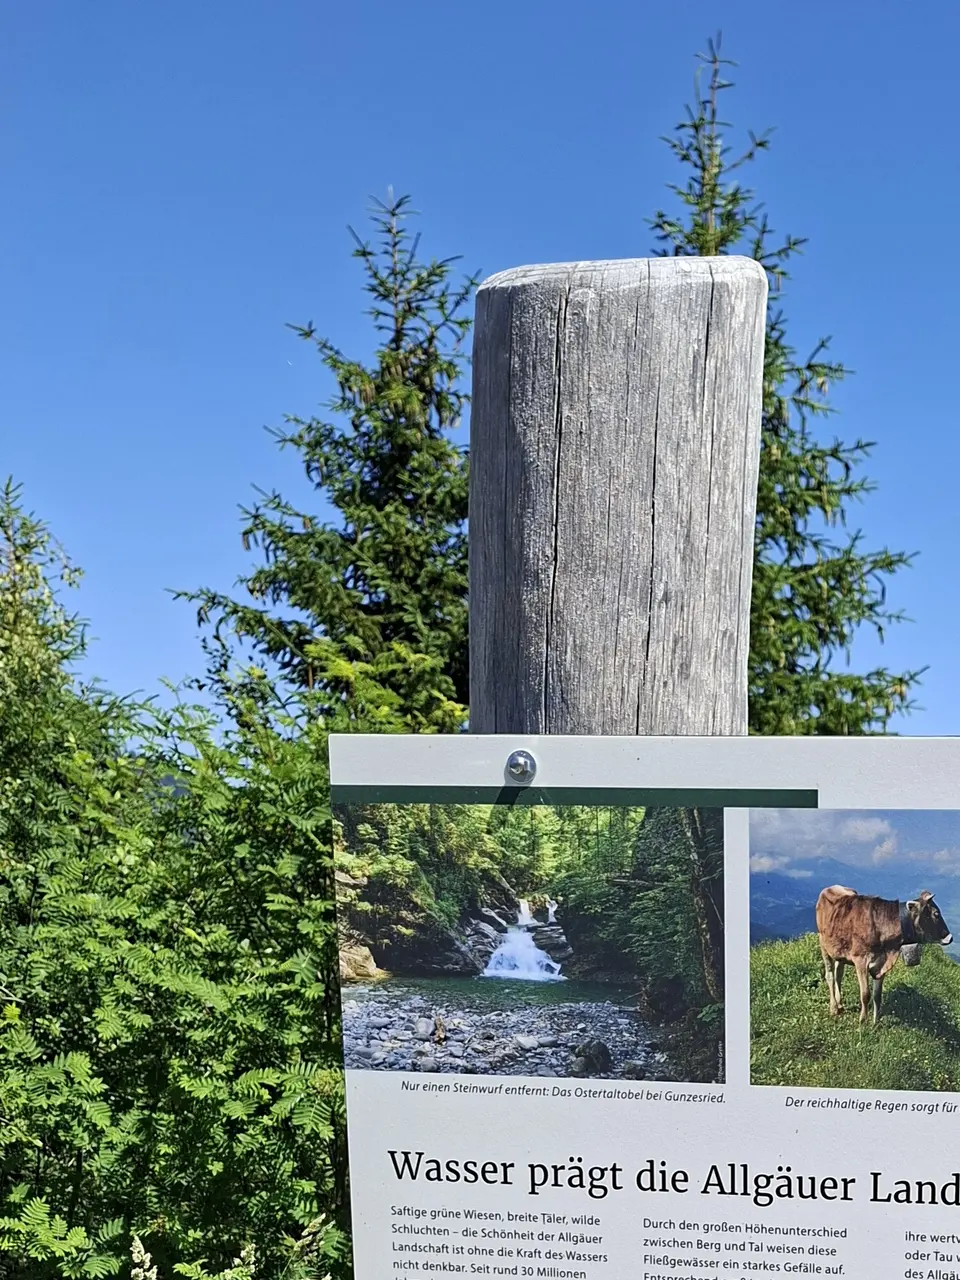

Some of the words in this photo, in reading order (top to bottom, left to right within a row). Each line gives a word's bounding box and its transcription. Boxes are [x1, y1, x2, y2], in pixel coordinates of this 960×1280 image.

[401, 1080, 421, 1091] Nur
[422, 1081, 450, 1092] einen
[453, 1082, 504, 1094] Steinwurf
[505, 1084, 549, 1097] entfernt:
[551, 1086, 573, 1098] Das
[574, 1087, 644, 1100] Ostertaltobel
[645, 1089, 663, 1101] bei
[664, 1090, 726, 1103] Gunzesried.
[785, 1096, 805, 1107] Der
[806, 1097, 872, 1112] reichhaltige
[874, 1099, 908, 1114] Regen
[910, 1102, 940, 1115] sorgt
[941, 1101, 958, 1113] für
[387, 1150, 515, 1185] Wasser
[527, 1156, 623, 1199] prägt
[636, 1159, 688, 1193] die
[700, 1163, 856, 1207] Allgäuer
[390, 1205, 427, 1219] Saftige
[429, 1207, 461, 1220] grüne
[463, 1208, 504, 1222] Wiesen,
[507, 1210, 538, 1223] breite
[540, 1212, 569, 1226] Täler,
[571, 1214, 600, 1226] wilde
[643, 1217, 676, 1230] Durch
[678, 1219, 699, 1231] den
[702, 1221, 742, 1234] großen
[744, 1222, 847, 1238] Höhenunterschied
[905, 1230, 927, 1242] ihre
[643, 1237, 693, 1249] zwischen
[696, 1238, 721, 1253] Berg
[724, 1241, 746, 1252] und
[747, 1241, 763, 1252] Tal
[766, 1243, 805, 1254] weisen
[807, 1244, 837, 1256] diese
[904, 1249, 931, 1261] oder
[932, 1250, 953, 1262] Tau
[392, 1259, 419, 1270] nicht
[421, 1260, 468, 1273] denkbar.
[470, 1263, 490, 1274] Seit
[492, 1265, 518, 1275] rund
[520, 1266, 534, 1277] 30
[536, 1266, 586, 1279] Millionen
[643, 1254, 720, 1269] Fließgewässer
[722, 1258, 739, 1269] ein
[742, 1260, 781, 1272] starkes
[783, 1261, 822, 1274] Gefälle
[824, 1264, 845, 1275] auf.
[904, 1268, 924, 1279] des
